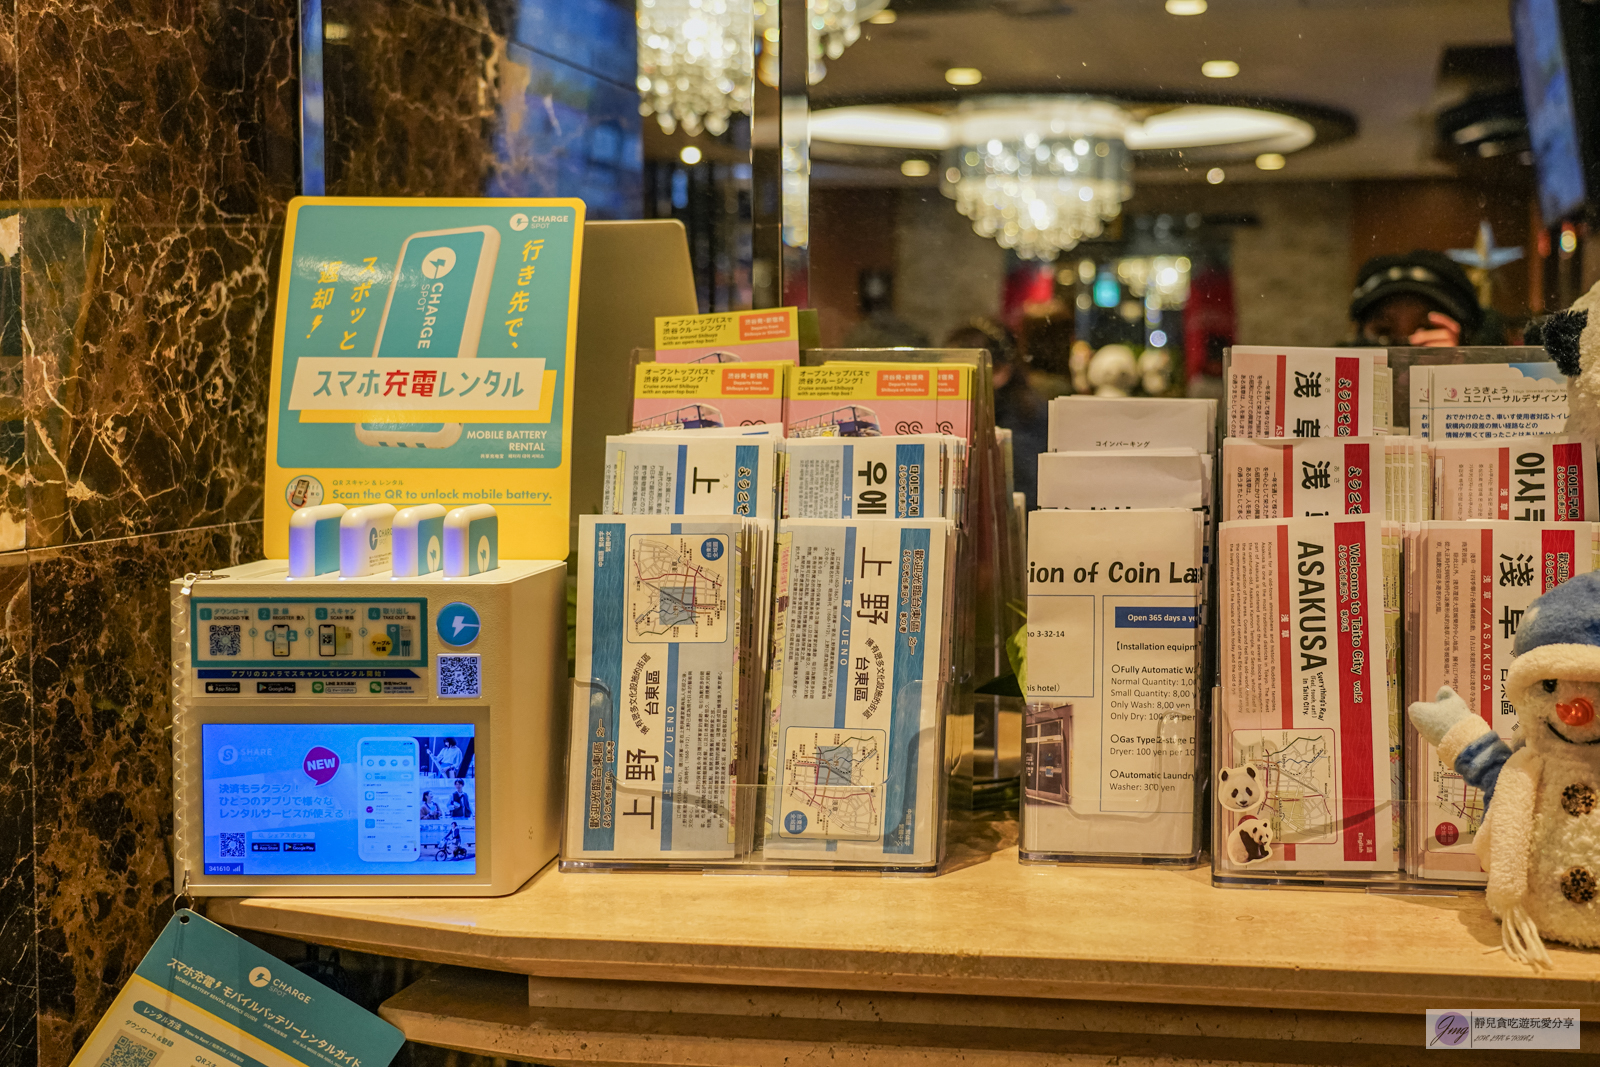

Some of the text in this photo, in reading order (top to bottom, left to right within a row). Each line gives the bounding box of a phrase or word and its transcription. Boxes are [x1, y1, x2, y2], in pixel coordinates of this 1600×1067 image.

[531, 215, 569, 223] CHARGE
[339, 256, 378, 350] スポッと
[416, 283, 431, 312] SPOT
[417, 282, 444, 349] CHARGE
[663, 317, 733, 327] オープントップバスで
[312, 369, 525, 397] スマホ充電レンタル
[1463, 386, 1509, 395] とうきょう
[466, 430, 547, 440] MOBILE BATTERY
[509, 442, 546, 451] RENTAL
[692, 466, 720, 494] 上
[332, 489, 552, 502] Scan the QR to unlock mobile battery.
[1567, 465, 1579, 519] 다이토구에
[1027, 561, 1064, 583] ion
[1073, 561, 1099, 583] of
[1108, 561, 1160, 583] Coin
[856, 546, 892, 625] 上野
[1298, 541, 1327, 672] ASAKUSA
[1127, 614, 1147, 623] Open
[1148, 614, 1162, 622] 365
[1163, 614, 1180, 623] days
[1349, 543, 1364, 703] Welcome to Taito City vol.2
[1037, 630, 1065, 638] 3-32-14
[840, 629, 849, 666] UENO
[1483, 623, 1491, 691] ASAKUSA
[231, 669, 386, 678] アプリのカメラでスキャンしてレンタル開始!
[1141, 665, 1184, 674] Automatic
[854, 656, 870, 702] 台東區
[1111, 677, 1179, 687] Normal Quantity:
[644, 670, 660, 716] 台東區
[1111, 689, 1191, 698] Small Quantity: 8,00
[1110, 701, 1129, 710] Only
[1131, 701, 1155, 709] Wash:
[1156, 702, 1175, 710] 8,00
[1110, 712, 1129, 721] Only
[1130, 713, 1147, 721] Dry:
[666, 705, 675, 743] UENO
[1136, 736, 1156, 745] Type
[241, 748, 273, 756] SHARE
[1110, 748, 1134, 757] Dryer:
[1136, 748, 1151, 756] 100
[1152, 750, 1167, 758] yen
[1169, 750, 1183, 758] per
[307, 757, 336, 771] NEW
[1119, 771, 1161, 779] Automatic
[623, 748, 659, 830] 上野
[1109, 783, 1142, 791] Washer:
[1160, 784, 1175, 792] yen
[219, 796, 333, 806] ひとつのアプリで様々な
[174, 974, 258, 1023] MOBILE BATTERY RENTAL SERVICE GUIDE
[268, 985, 287, 999] SPOT
[272, 978, 311, 1005] CHARGE
[143, 1005, 182, 1032] レンタル方法
[223, 985, 363, 1067] モバイルバッテリーレンタルガイド
